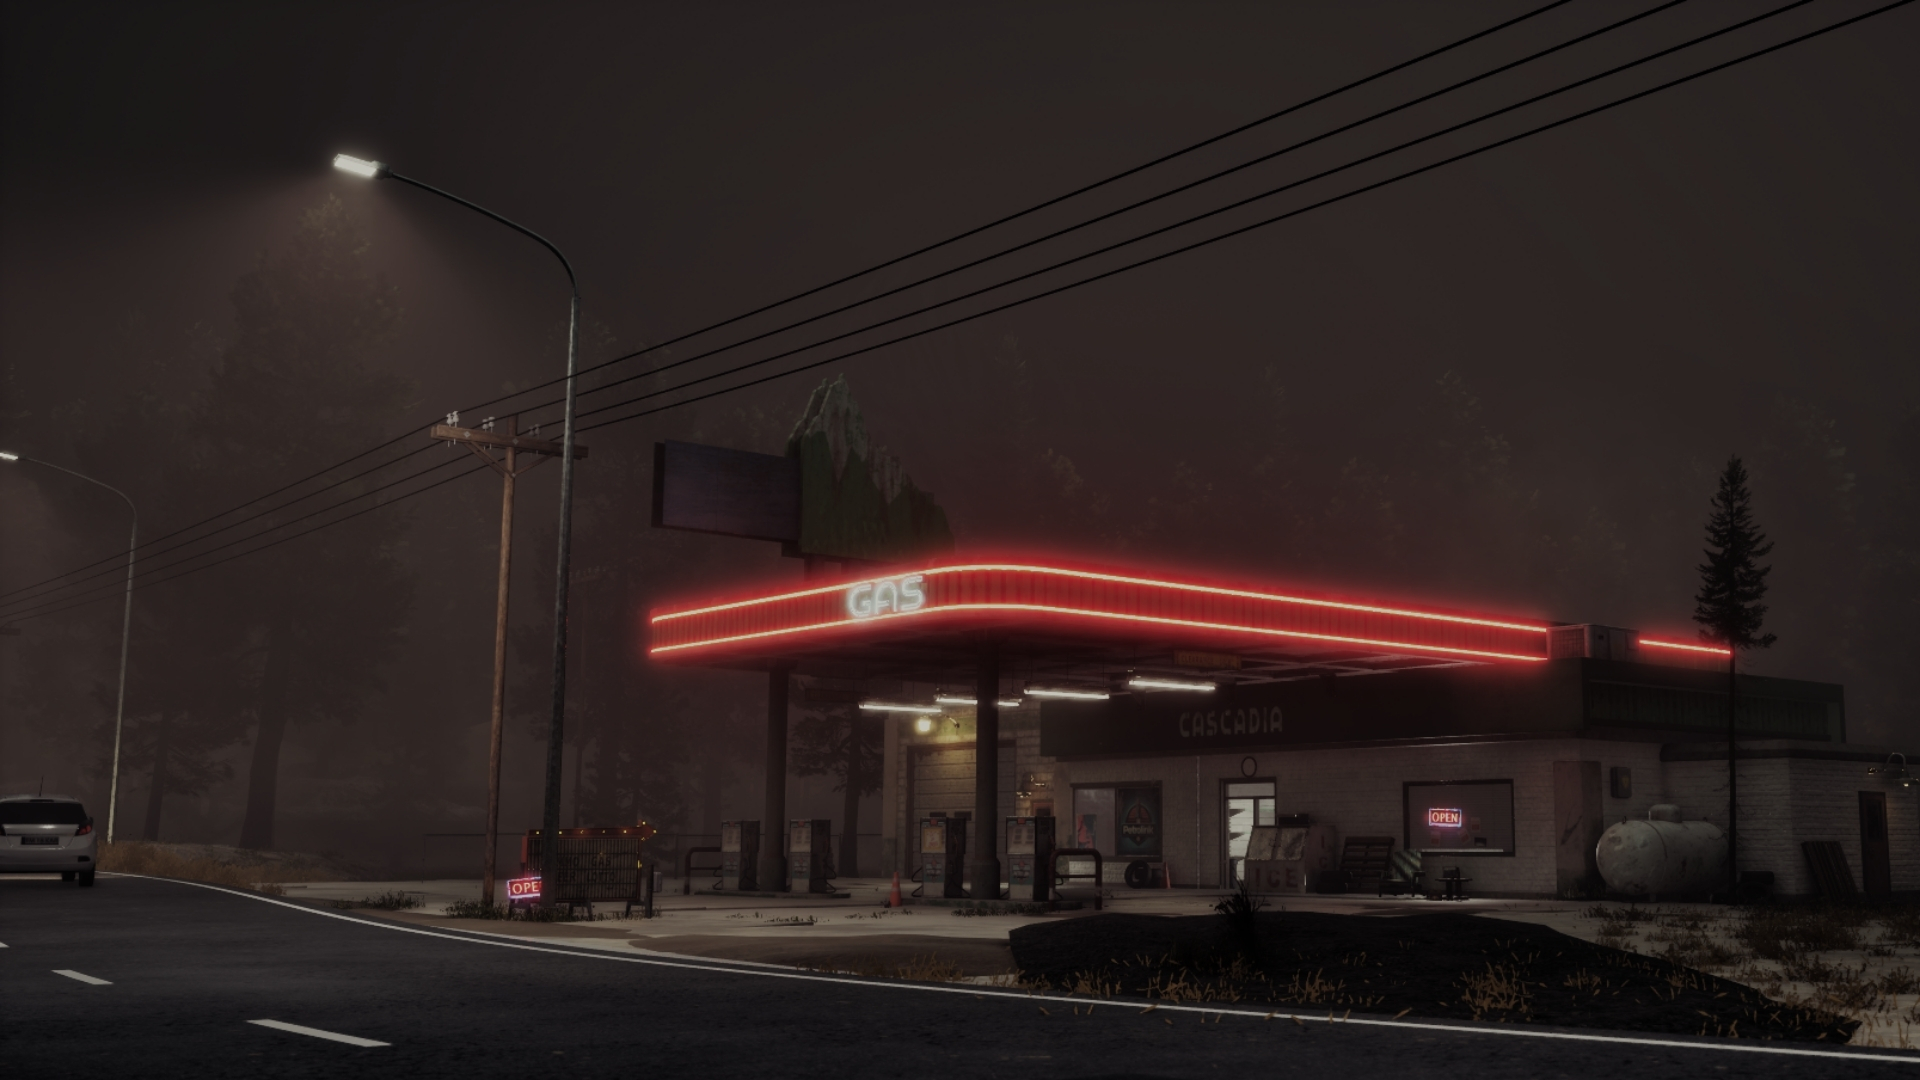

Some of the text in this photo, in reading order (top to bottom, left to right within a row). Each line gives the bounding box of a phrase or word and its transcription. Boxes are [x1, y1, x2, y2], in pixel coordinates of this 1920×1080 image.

[848, 575, 923, 617] GAS
[1179, 705, 1283, 738] CASCADIA
[1432, 812, 1458, 823] OPEN
[592, 856, 611, 867] GAS
[1255, 867, 1298, 889] ICE
